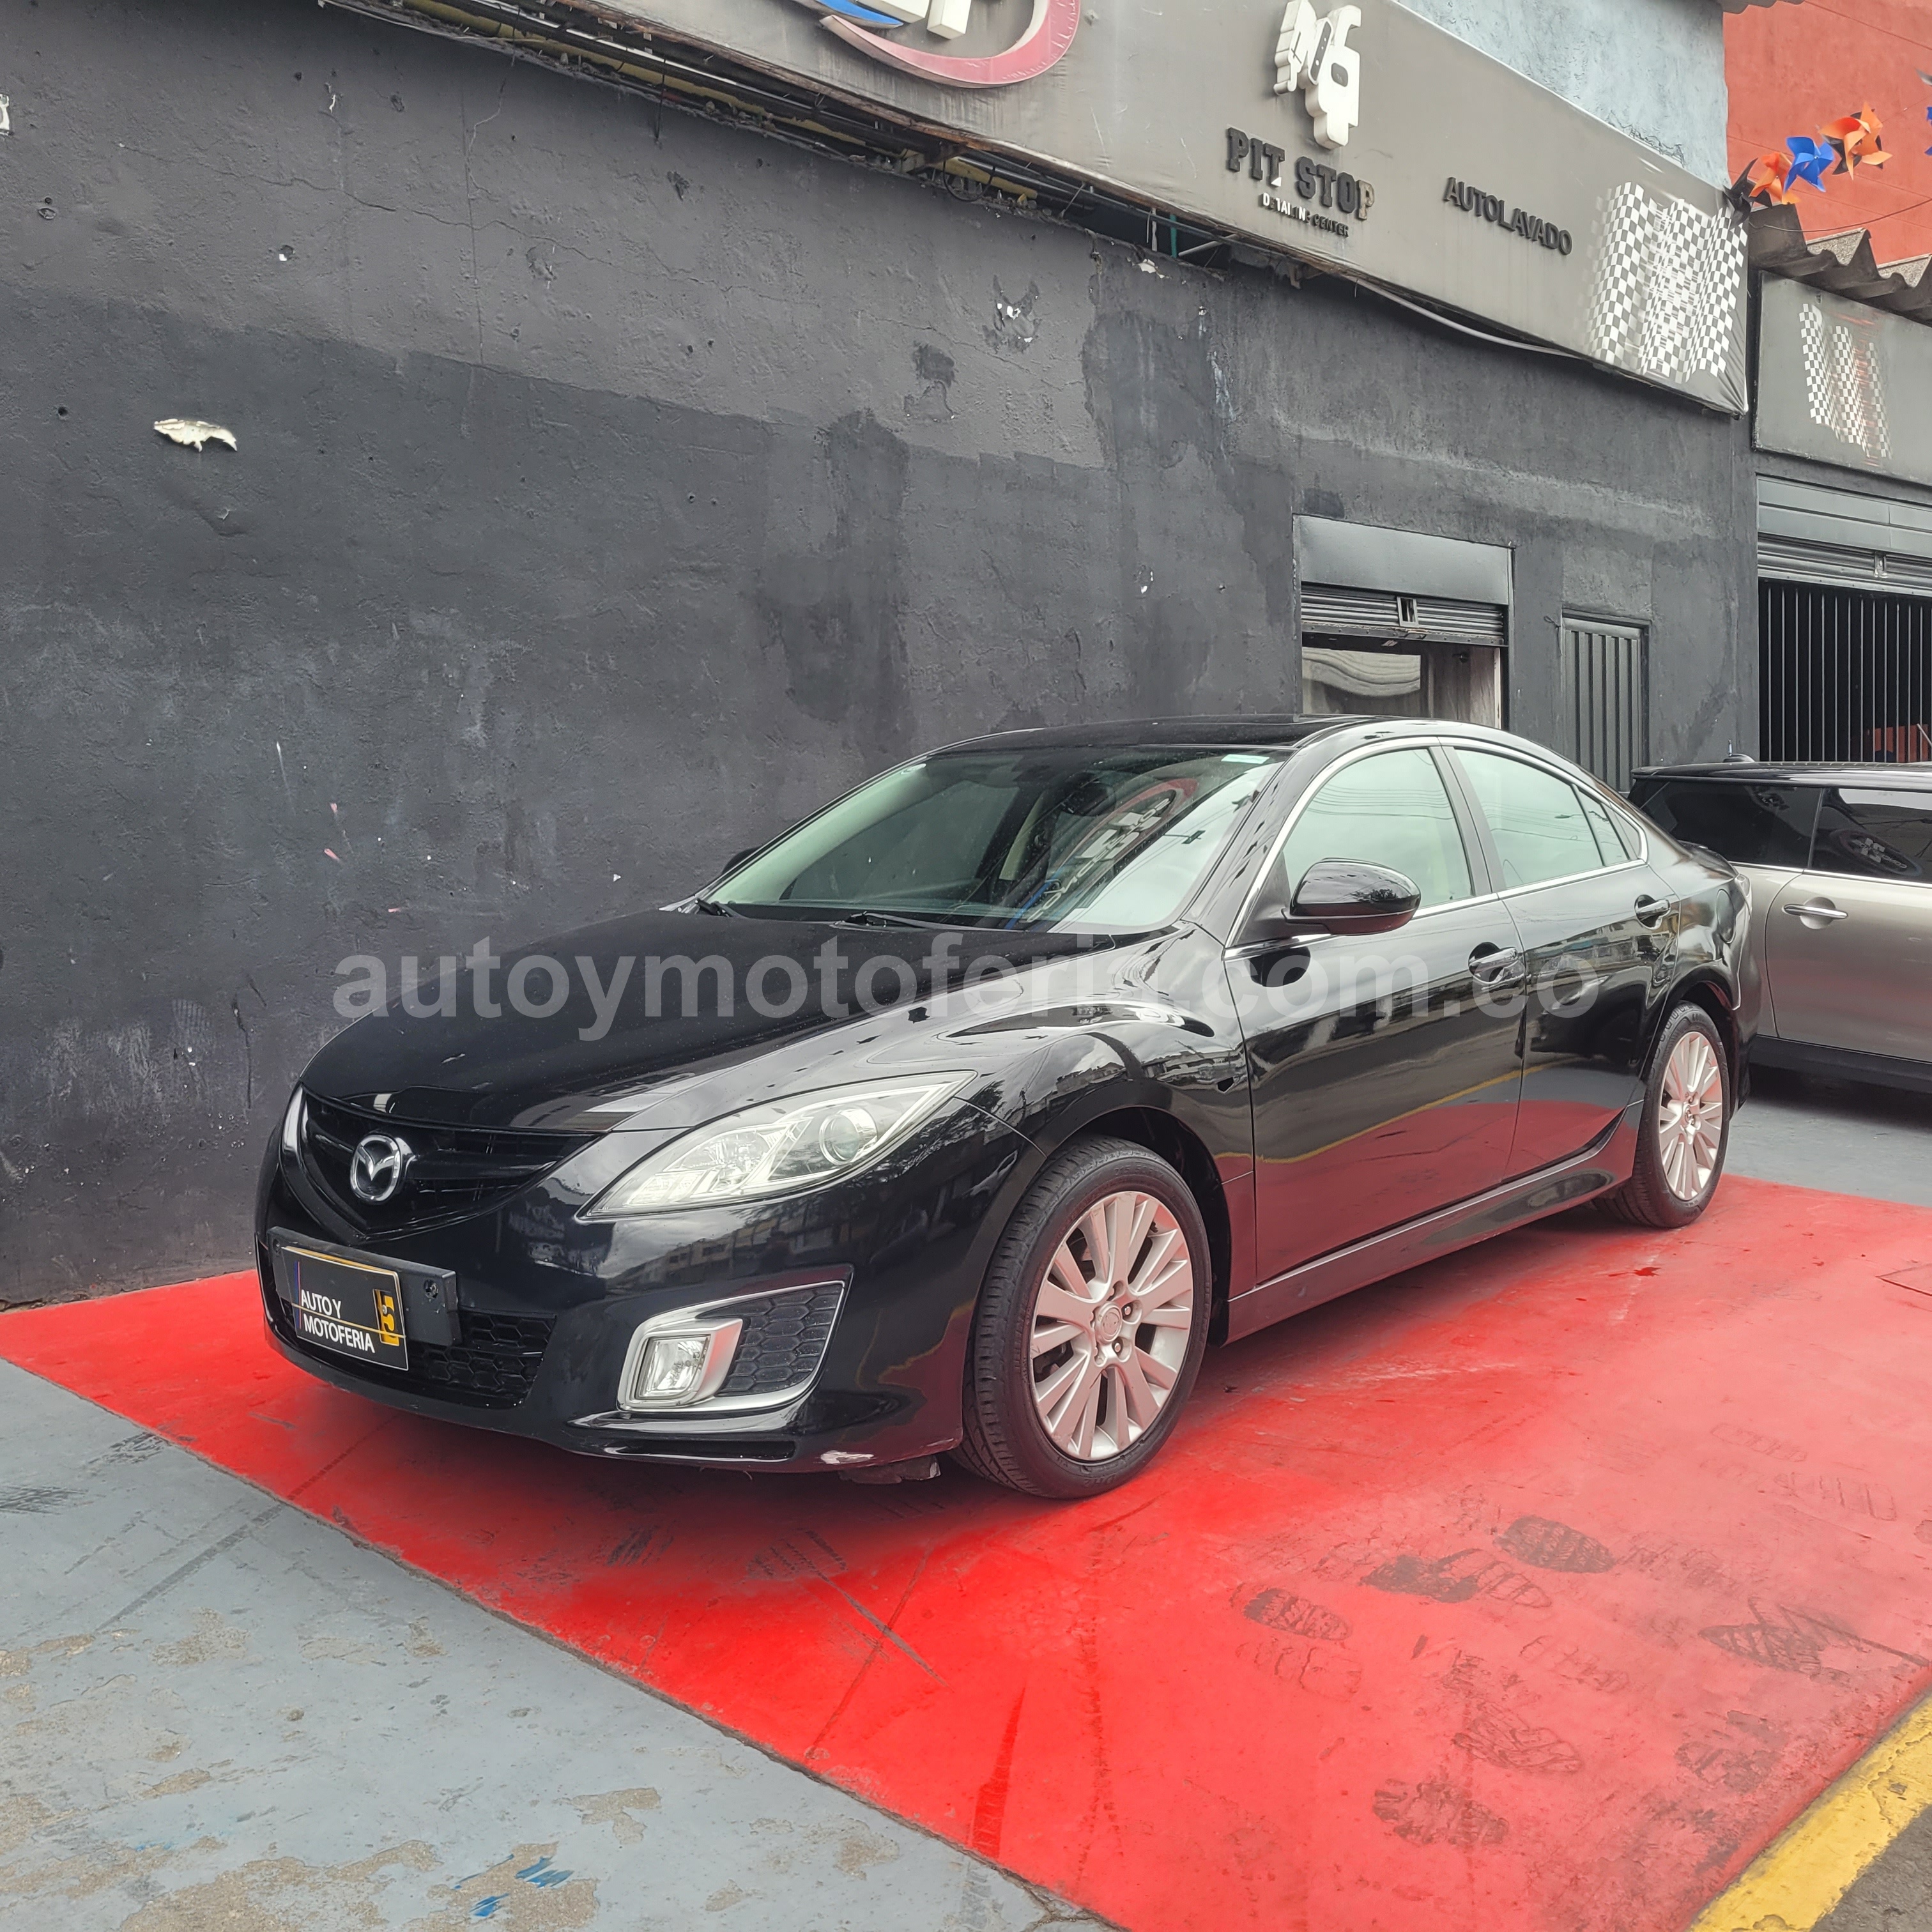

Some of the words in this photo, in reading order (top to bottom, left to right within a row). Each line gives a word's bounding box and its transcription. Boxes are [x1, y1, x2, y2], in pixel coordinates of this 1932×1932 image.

[1226, 126, 1285, 187] PIT
[1296, 155, 1374, 220] STOP
[1443, 176, 1572, 255] AUTOLAVADO
[301, 1289, 332, 1317] AUTO
[332, 1298, 342, 1319] Y
[303, 1314, 375, 1353] MOTOFERIA
